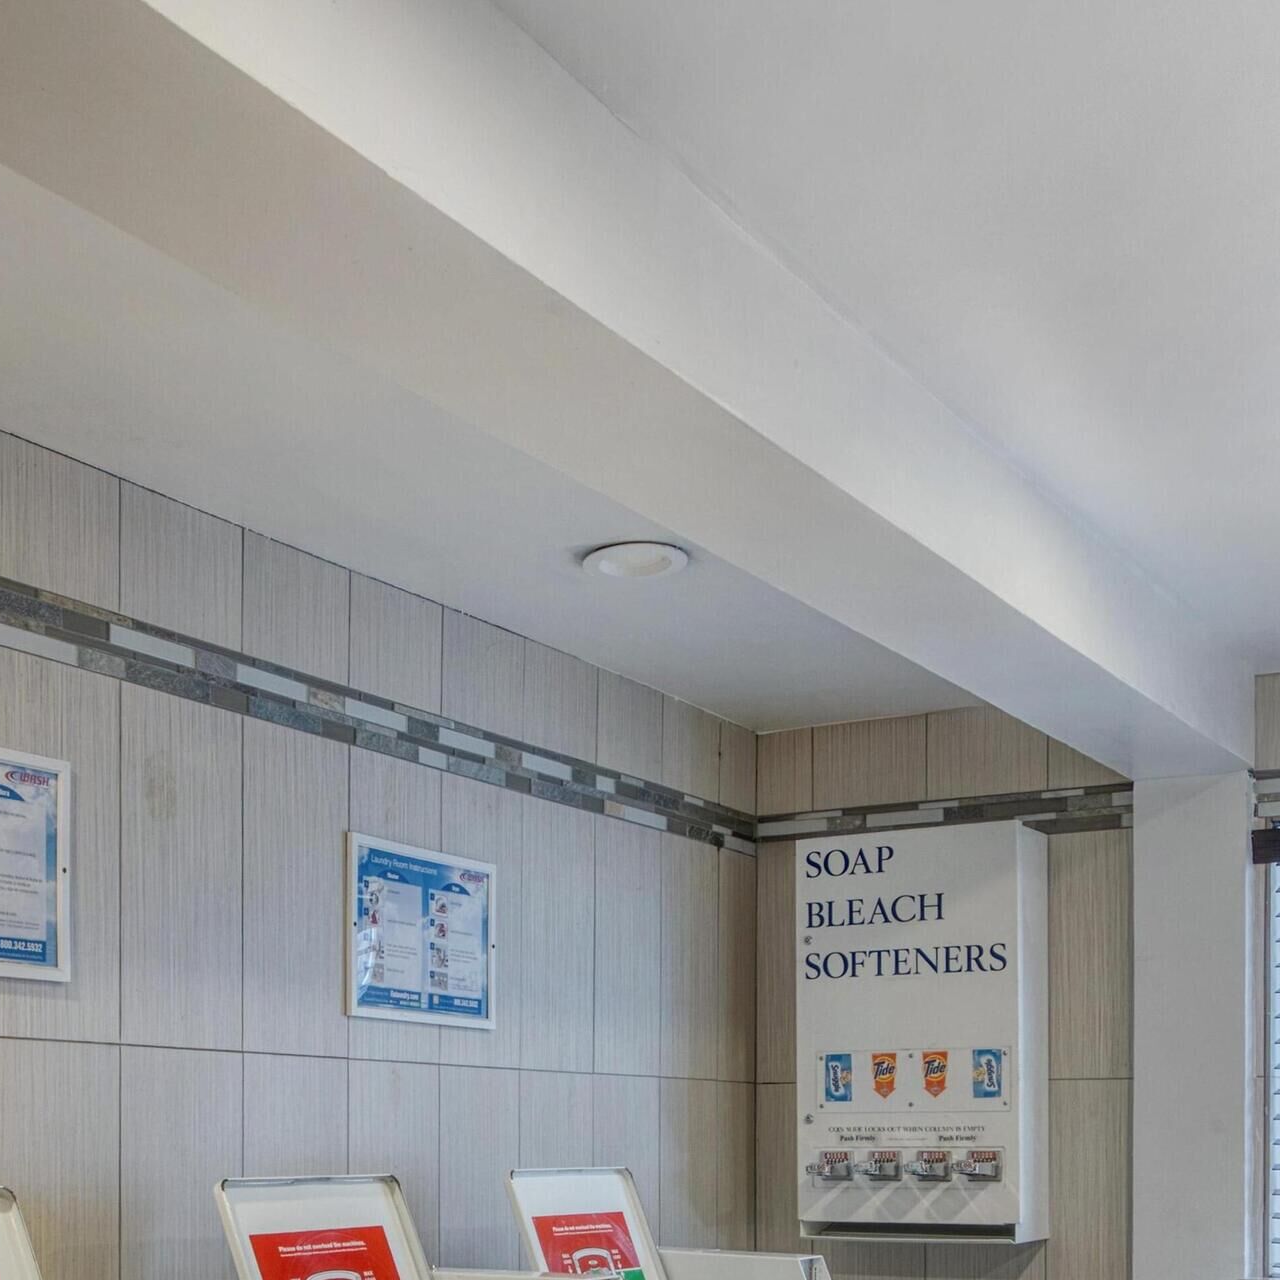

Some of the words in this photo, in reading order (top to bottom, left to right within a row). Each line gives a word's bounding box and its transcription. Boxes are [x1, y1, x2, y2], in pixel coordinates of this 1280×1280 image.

[21, 771, 49, 786] WASH
[371, 854, 392, 868] Laundry
[392, 858, 409, 869] Room
[806, 845, 895, 878] SOAP
[805, 892, 945, 928] BLEACH
[805, 942, 1008, 980] SOFTENERS
[830, 1063, 840, 1093] Snuggle
[873, 1060, 896, 1079] Tide
[924, 1059, 946, 1078] Tide
[985, 1058, 996, 1089] Snuggle
